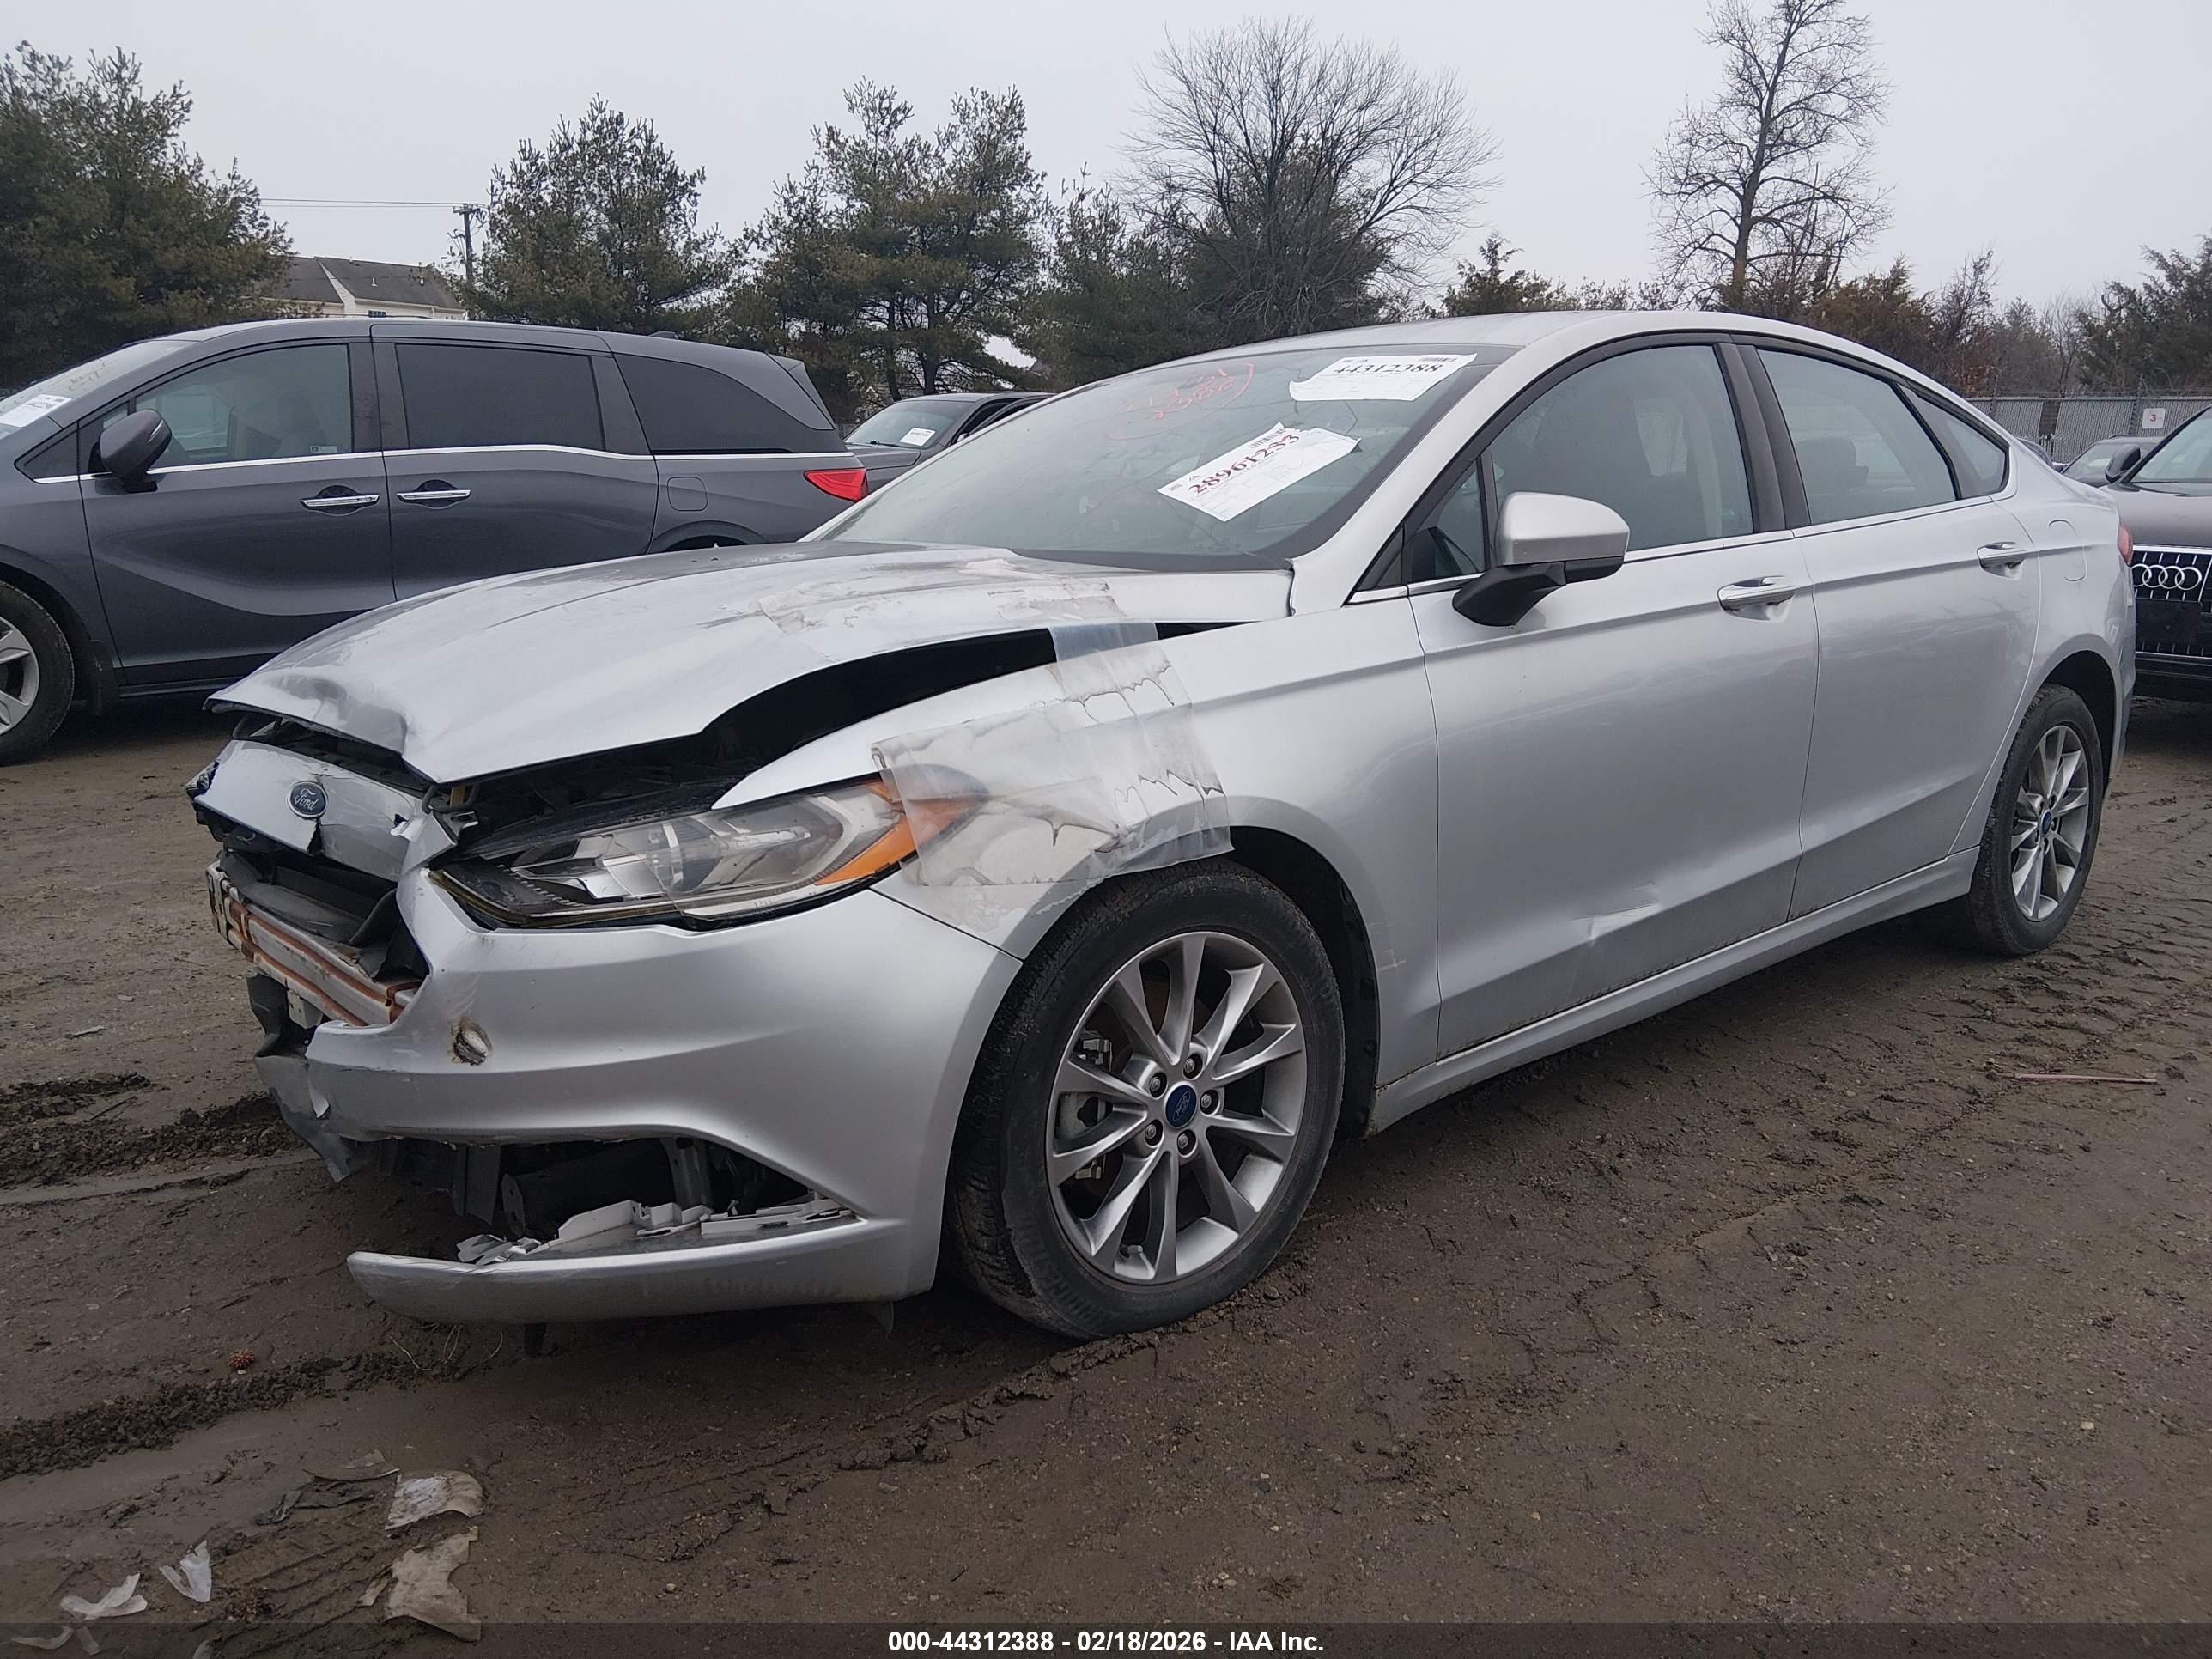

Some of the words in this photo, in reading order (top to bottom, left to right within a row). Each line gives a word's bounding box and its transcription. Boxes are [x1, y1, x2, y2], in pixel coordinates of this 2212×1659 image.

[1334, 363, 1443, 374] 44312388
[1188, 434, 1300, 495] 28961233
[294, 787, 320, 811] Ford
